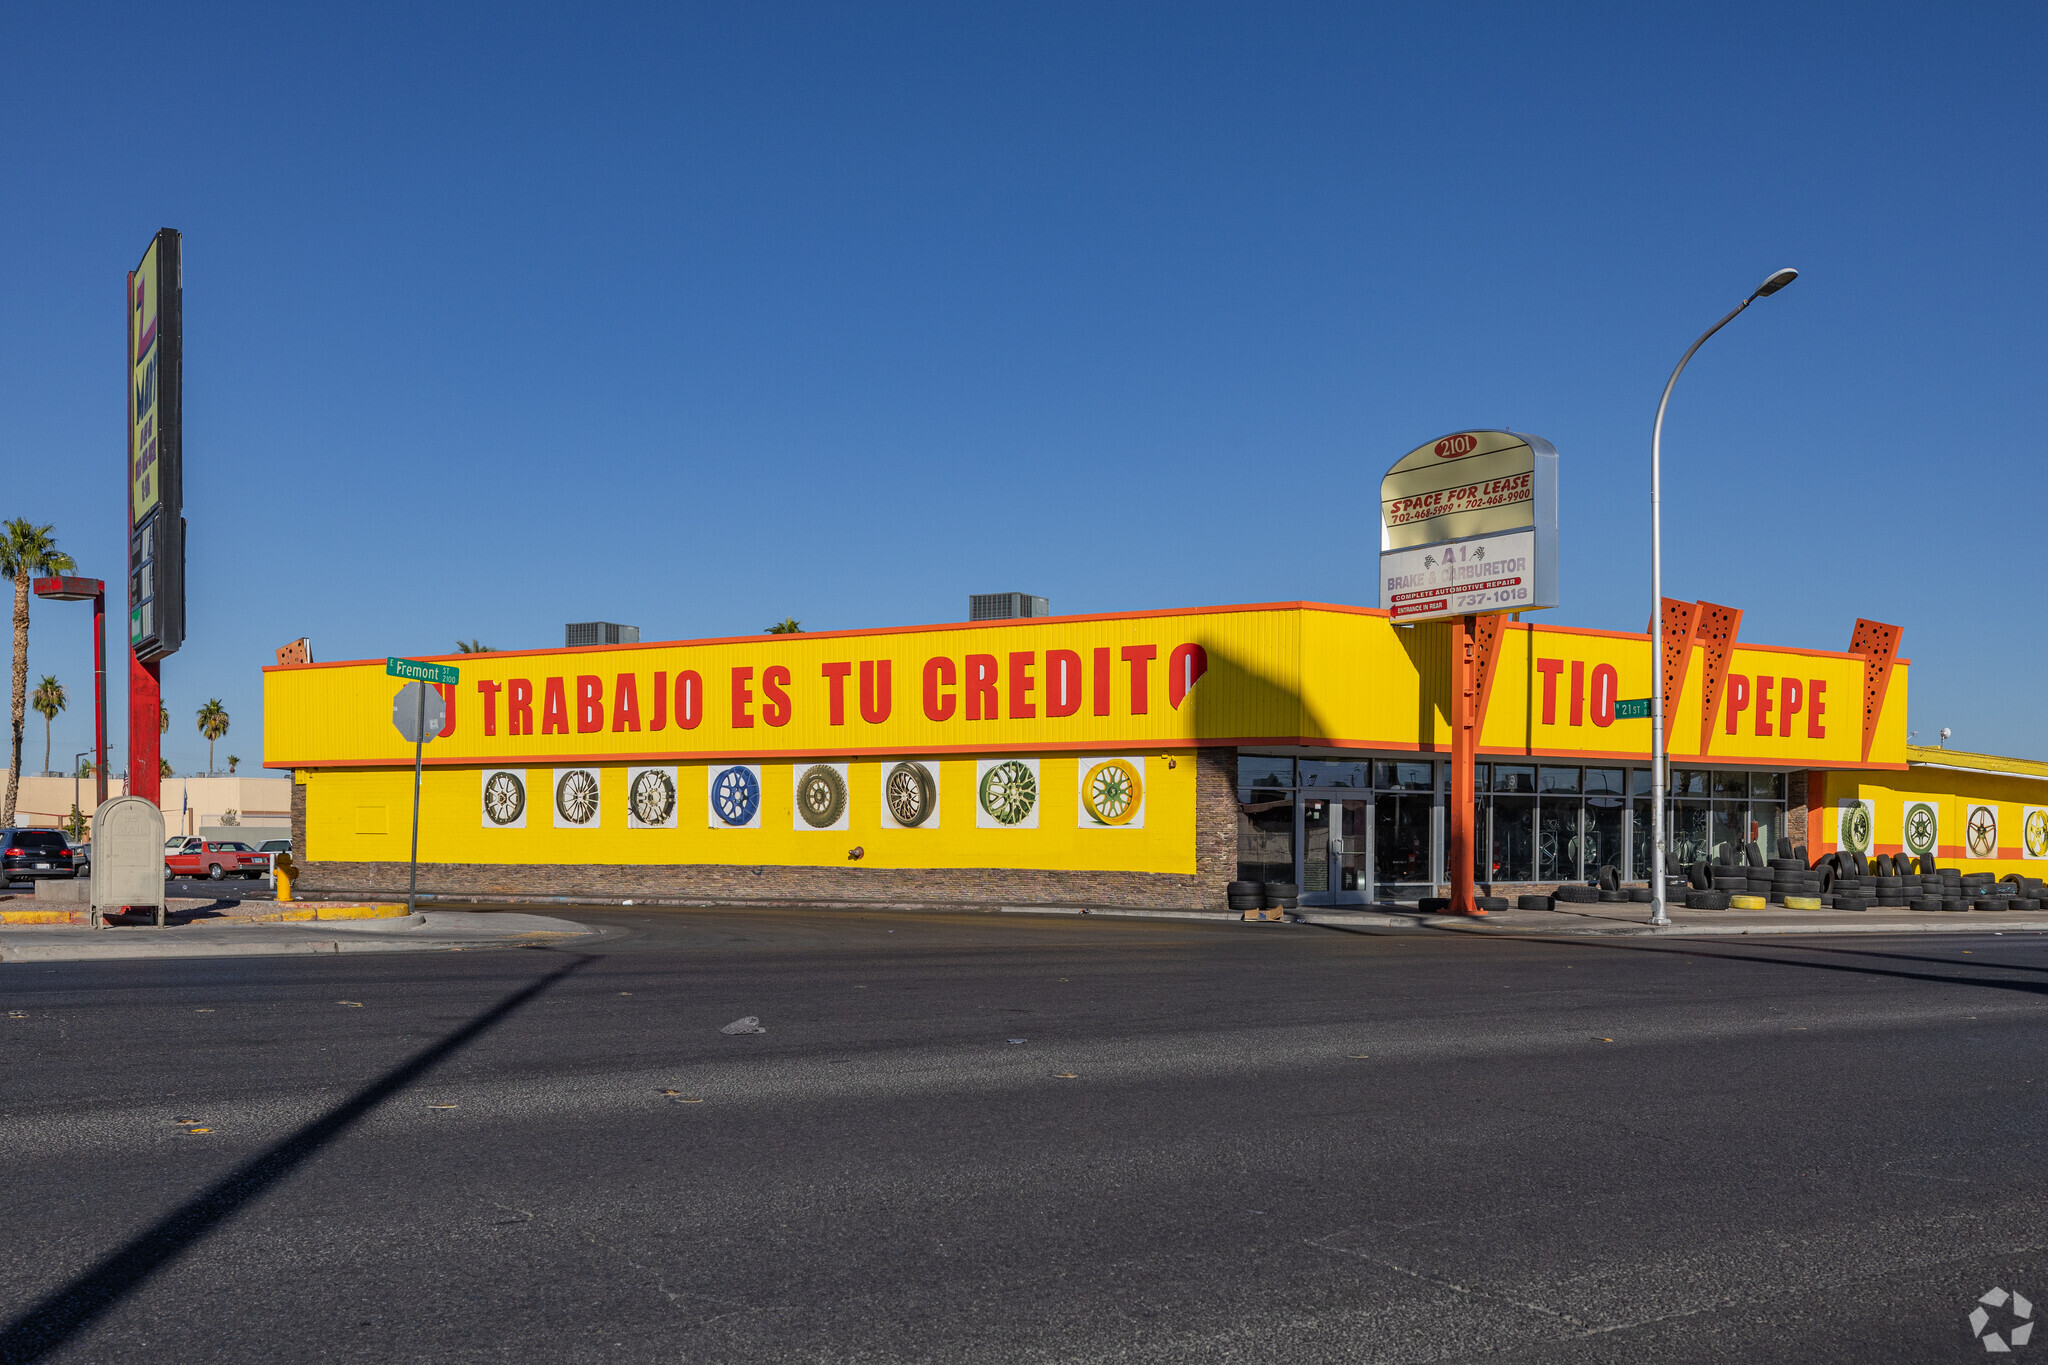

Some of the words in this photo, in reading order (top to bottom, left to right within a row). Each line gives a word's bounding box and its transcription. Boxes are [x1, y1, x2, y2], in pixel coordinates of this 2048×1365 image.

[135, 273, 158, 367] Z
[1440, 435, 1472, 457] 2101
[1390, 492, 1443, 514] SPACE
[1447, 485, 1478, 502] FOR
[1483, 474, 1531, 496] LEASE
[1391, 503, 1454, 524] 702-468-5999
[1465, 488, 1531, 509] 702-468-9900
[1387, 572, 1425, 591] BRAKE
[1428, 571, 1437, 585] &
[1440, 557, 1526, 583] CARBURETOR
[1396, 590, 1433, 601] COMPLETE
[1435, 583, 1484, 595] AUTOMOTIVE
[1486, 578, 1516, 588] REPAIR
[1457, 587, 1528, 607] 737-1018
[1397, 604, 1423, 614] ENTRANCE
[1429, 602, 1443, 610] REAR
[389, 658, 394, 667] E
[396, 661, 440, 680] Fremont
[442, 667, 450, 675] ST
[442, 675, 456, 684] 2100
[477, 669, 703, 736] TRABAJO
[731, 665, 792, 728] ES
[821, 659, 892, 726] TU
[922, 642, 1208, 722] CREDITO
[1537, 657, 1618, 728] TIO
[1725, 673, 1827, 739] PEPE
[1621, 704, 1641, 715] 21ST
